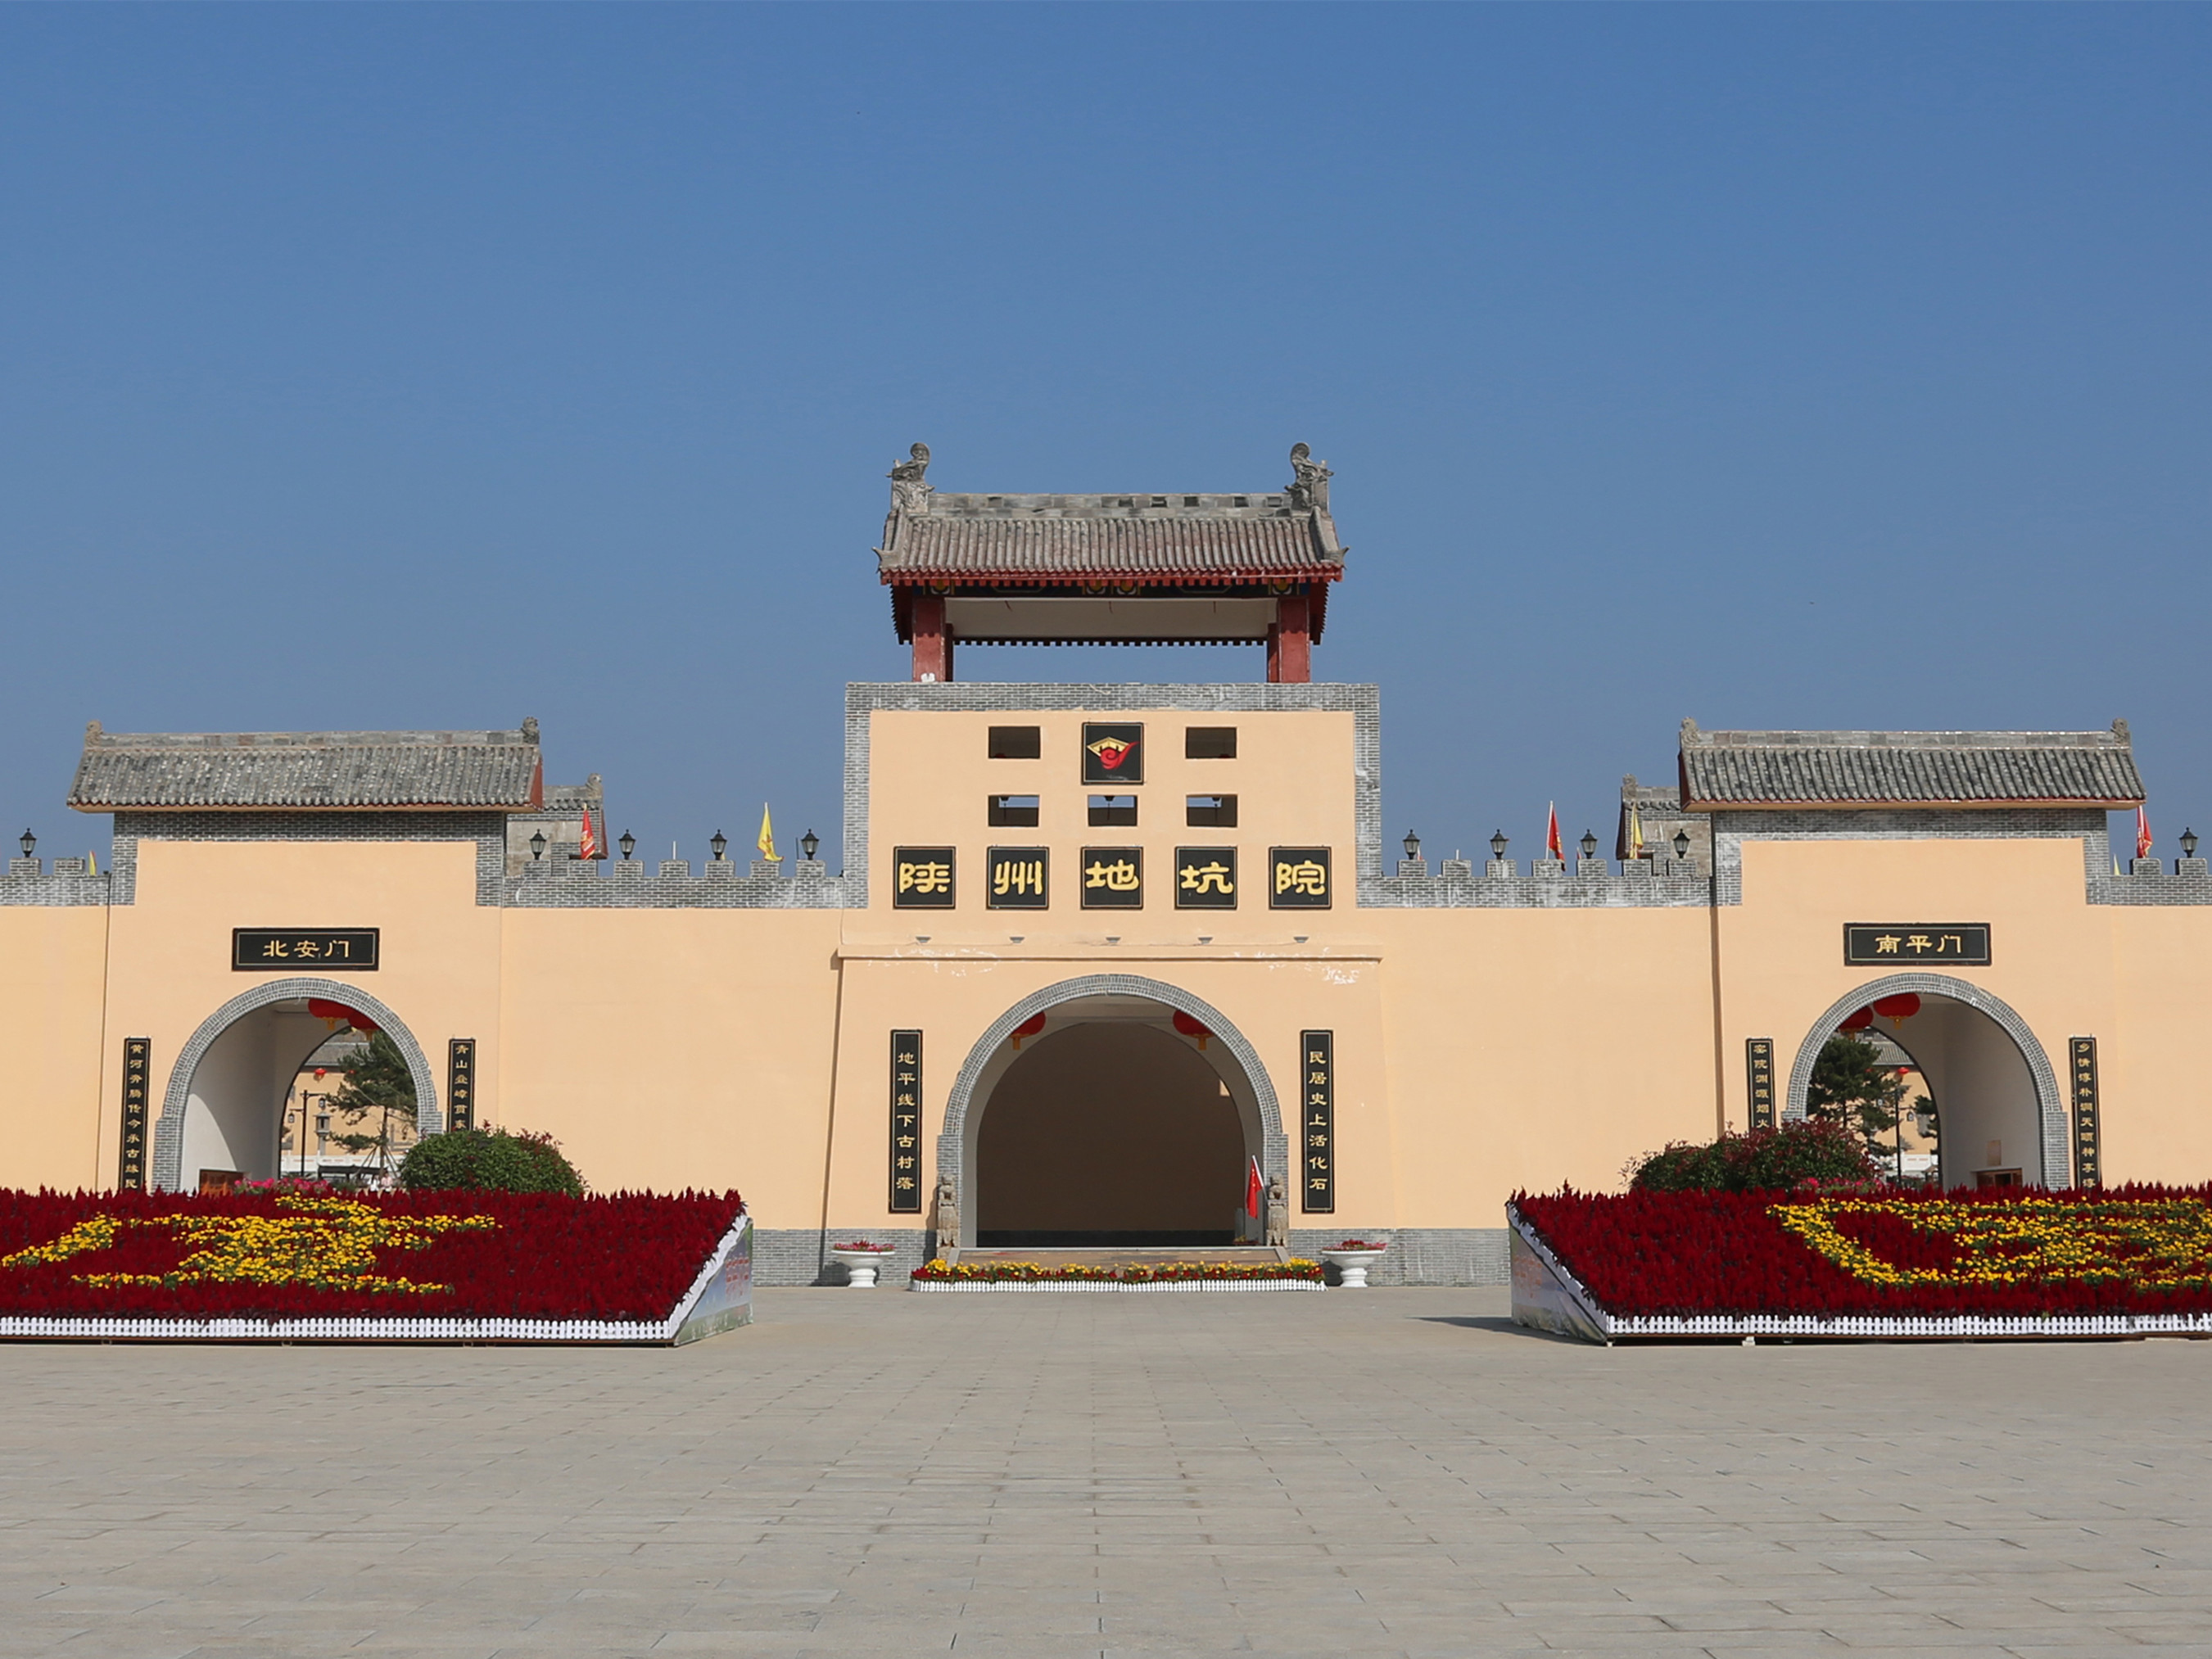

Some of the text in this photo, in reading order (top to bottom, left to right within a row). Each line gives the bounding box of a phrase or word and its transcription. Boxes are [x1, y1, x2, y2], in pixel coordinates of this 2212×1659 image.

[898, 859, 1326, 895] 陕州地坑院
[262, 940, 350, 958] 北安门
[1875, 934, 1962, 954] 南平门
[897, 1051, 916, 1190] 地平线下古村落
[1309, 1051, 1328, 1191] 民居史上活化石
